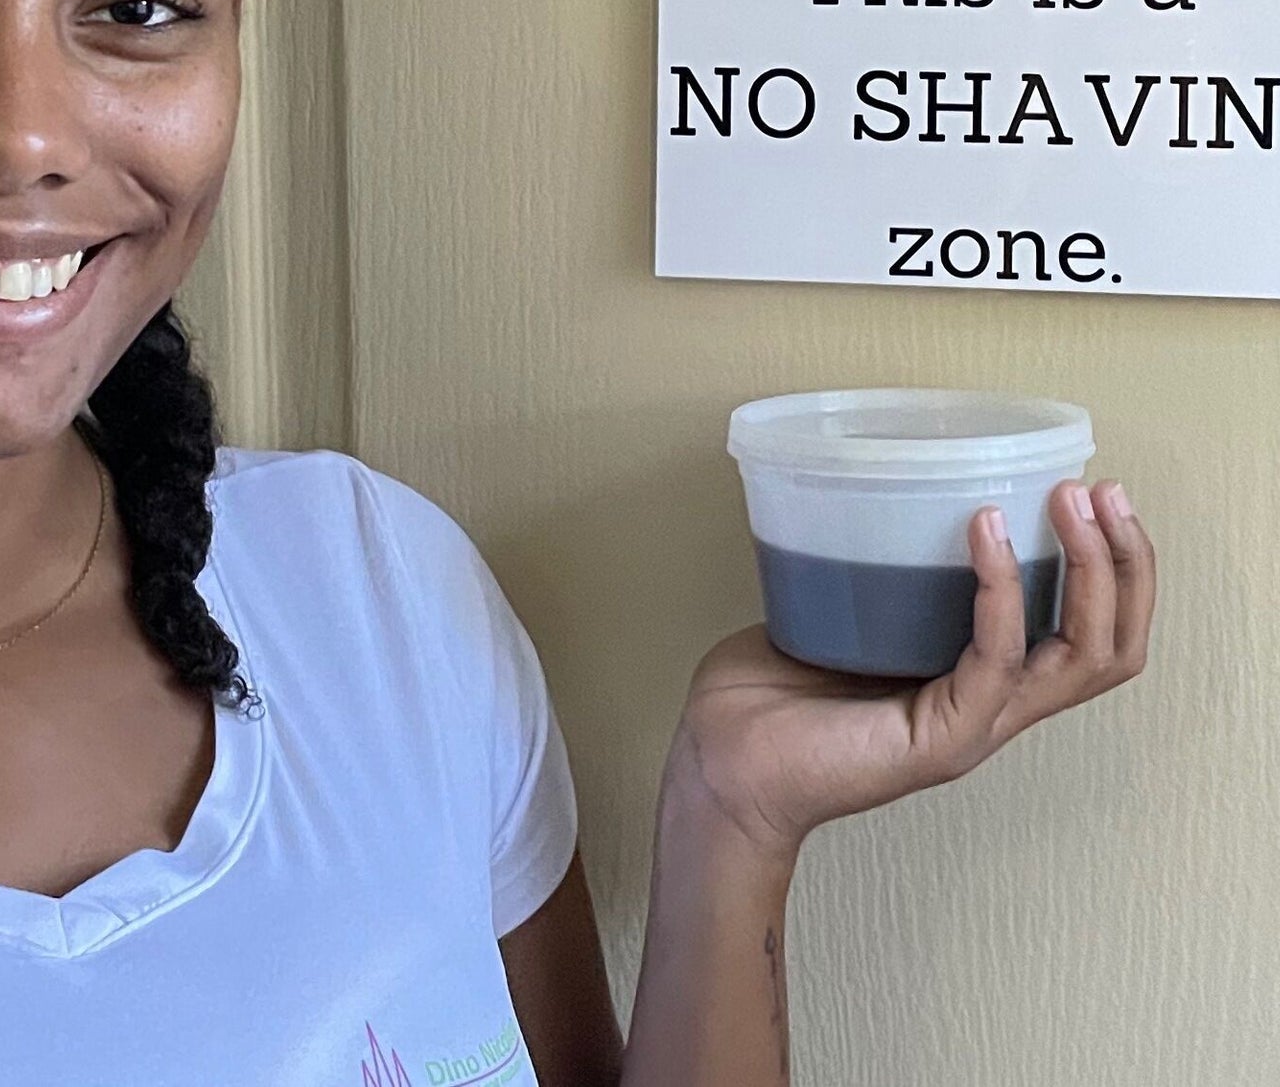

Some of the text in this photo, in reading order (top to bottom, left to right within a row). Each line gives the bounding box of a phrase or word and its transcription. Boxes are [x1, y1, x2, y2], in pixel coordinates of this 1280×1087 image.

[670, 66, 816, 139] NO
[888, 227, 1122, 284] zone.
[425, 1055, 480, 1086] Dino
